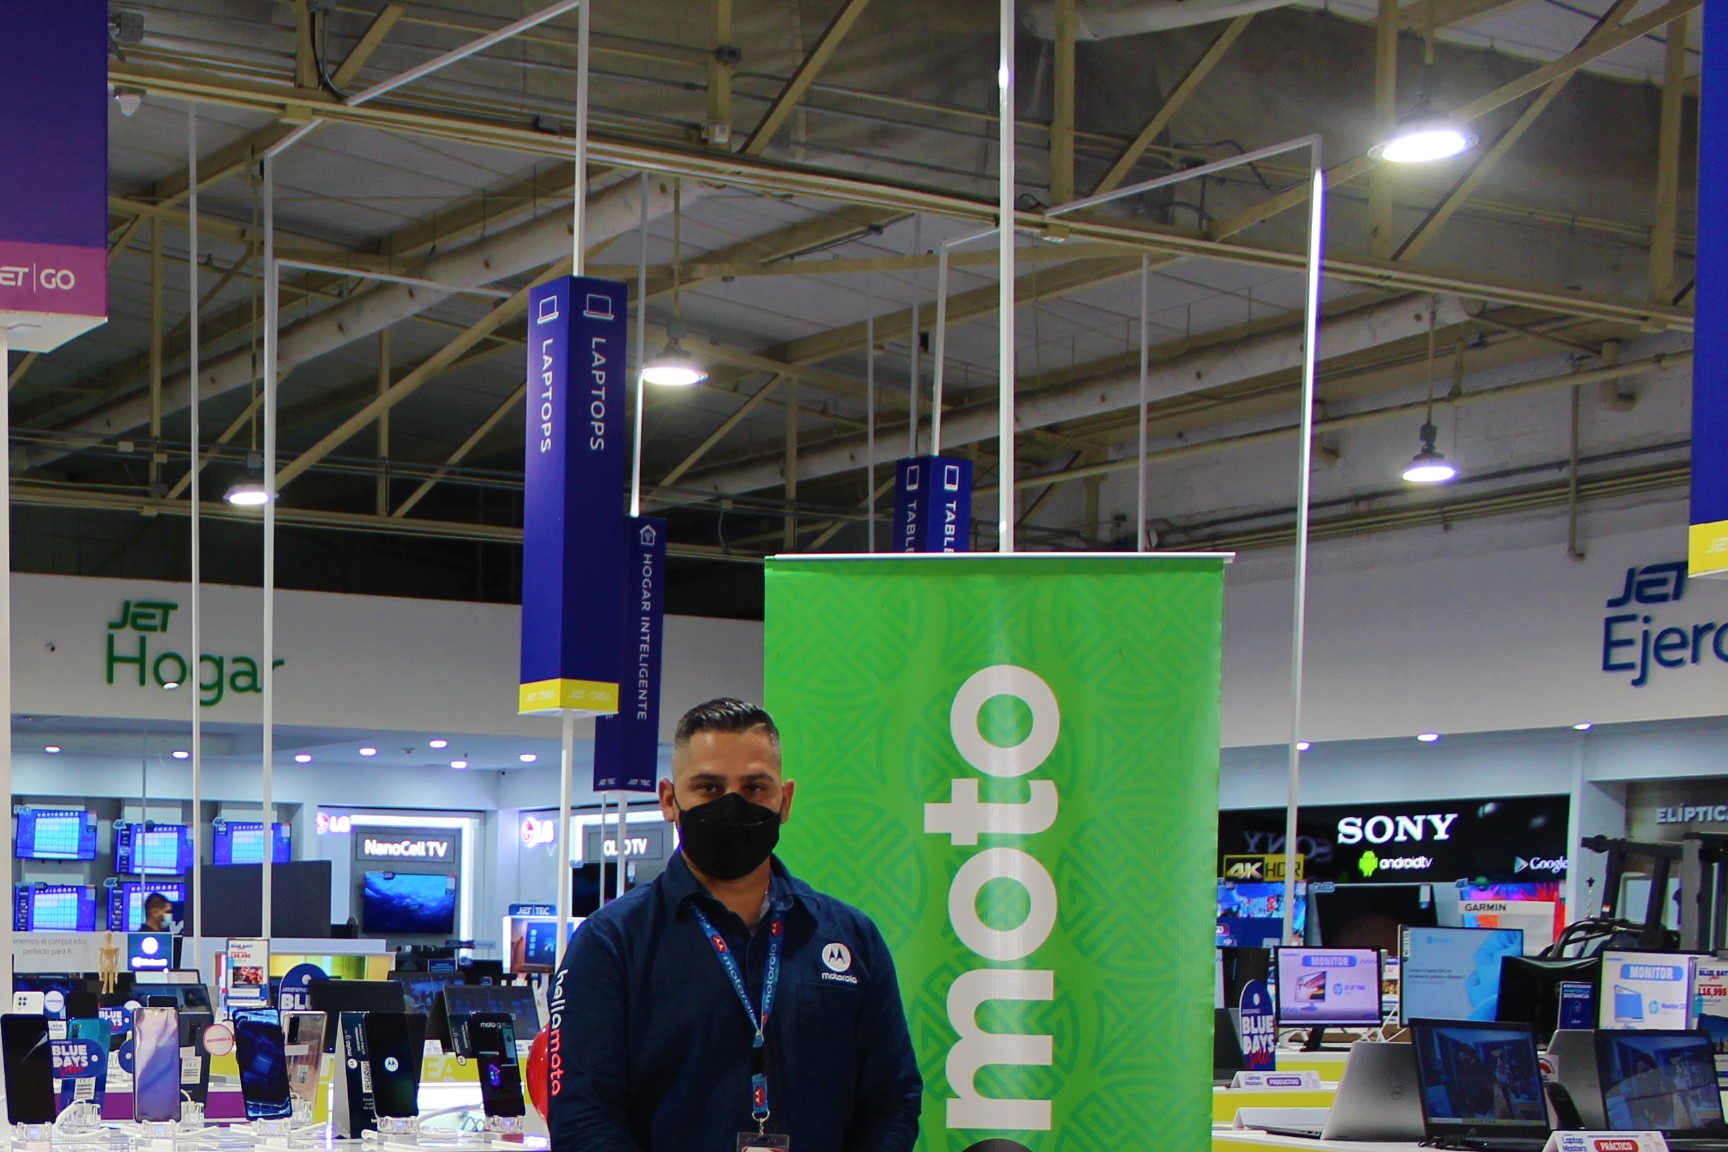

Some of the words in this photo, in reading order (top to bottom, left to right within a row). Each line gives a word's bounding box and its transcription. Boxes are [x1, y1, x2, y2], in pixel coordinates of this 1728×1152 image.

[40, 269, 76, 291] GO
[540, 339, 553, 453] LAPTOPS
[590, 337, 606, 451] LAPTOPS
[906, 500, 917, 553] TABLE
[944, 501, 956, 553] TABLE
[640, 553, 652, 612] HOGAR
[1606, 560, 1688, 608] JET
[108, 600, 178, 632] JET
[1602, 613, 1728, 687] Ejerc
[637, 616, 650, 720] INTELIGENTE
[1656, 803, 1728, 823] ELÍPTIC
[330, 815, 351, 833] LG
[1338, 813, 1458, 844] SONY
[365, 839, 426, 857] NanoCell
[427, 841, 447, 858] TV
[604, 838, 630, 856] OLD
[1226, 862, 1263, 879] 4K
[516, 906, 532, 915] JET
[535, 906, 550, 915] TEC
[1464, 902, 1507, 912] GARMIN
[1310, 956, 1349, 967] MONITOR
[765, 943, 778, 1008] motorola
[822, 972, 858, 984] motorola
[1630, 968, 1674, 980] MONITOR
[1242, 1015, 1273, 1034] BLUE
[52, 1045, 87, 1056] BLUE
[1243, 1034, 1275, 1053] DAYS
[53, 1056, 89, 1068] DAYS
[1600, 1140, 1632, 1151] PRÁCTICO
